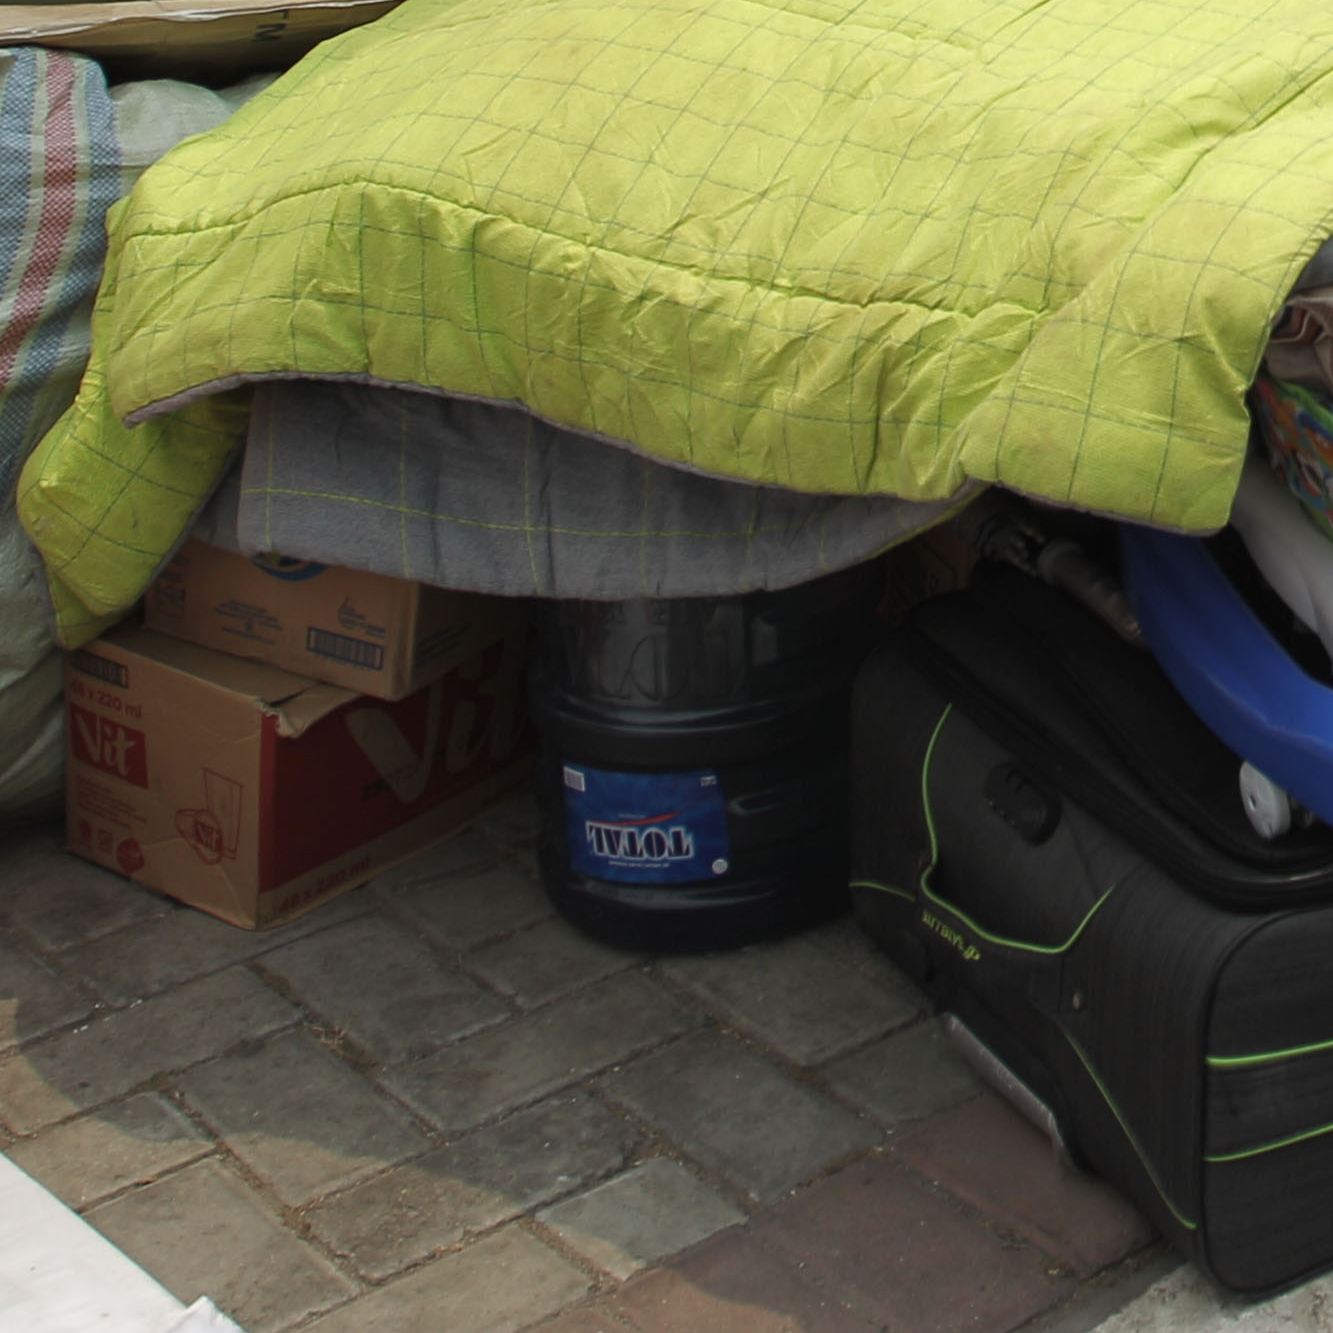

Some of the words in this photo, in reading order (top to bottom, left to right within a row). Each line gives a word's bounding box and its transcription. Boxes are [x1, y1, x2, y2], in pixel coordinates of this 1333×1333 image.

[97, 690, 122, 711] 220
[74, 711, 136, 776] Vit
[585, 821, 695, 860] TOTAL
